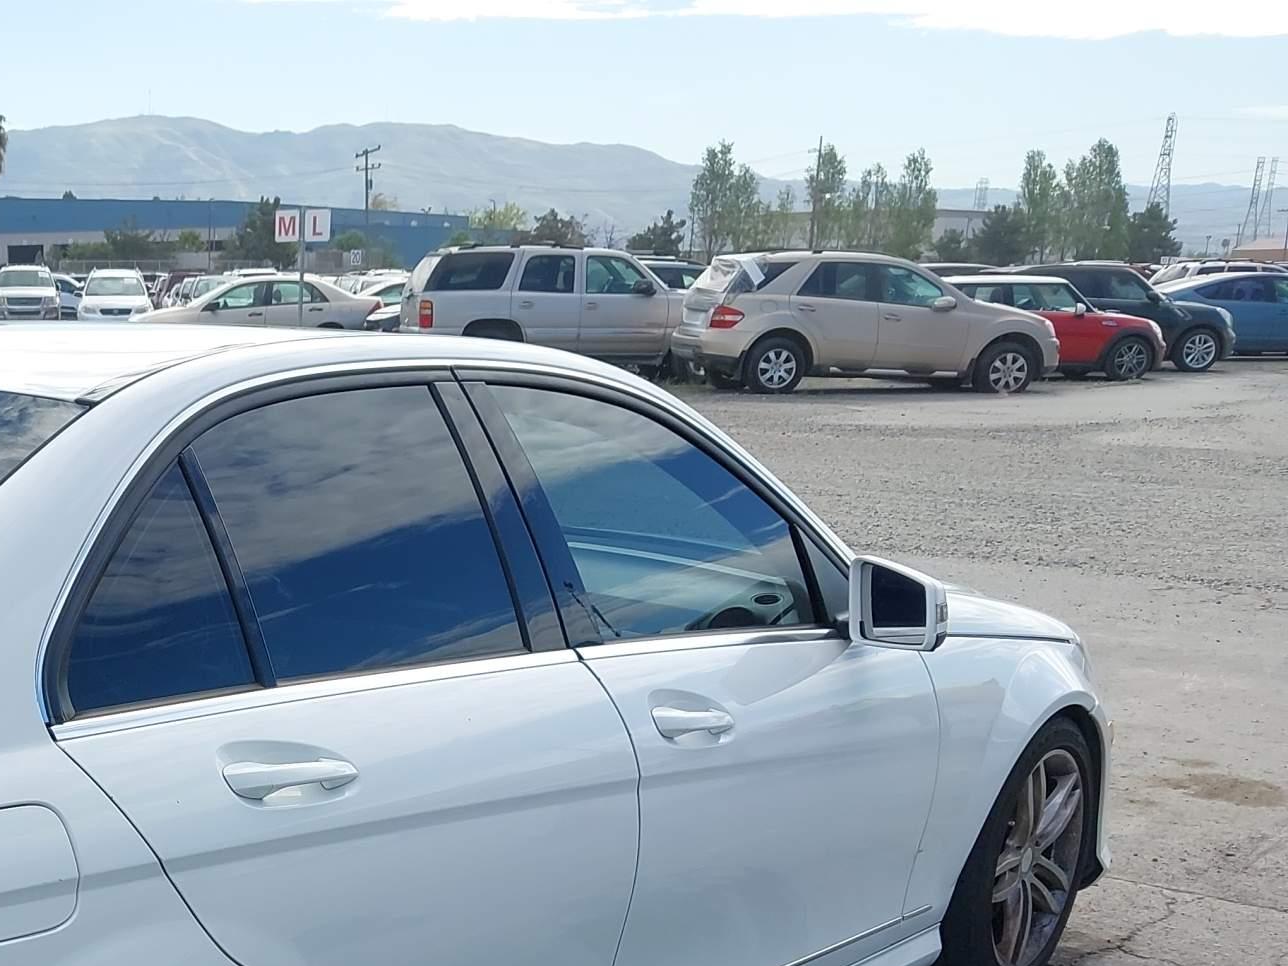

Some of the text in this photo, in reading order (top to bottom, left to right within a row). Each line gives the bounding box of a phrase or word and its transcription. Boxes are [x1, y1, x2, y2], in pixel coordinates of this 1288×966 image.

[278, 215, 296, 237] M
[312, 215, 323, 236] L
[351, 251, 361, 264] 20
